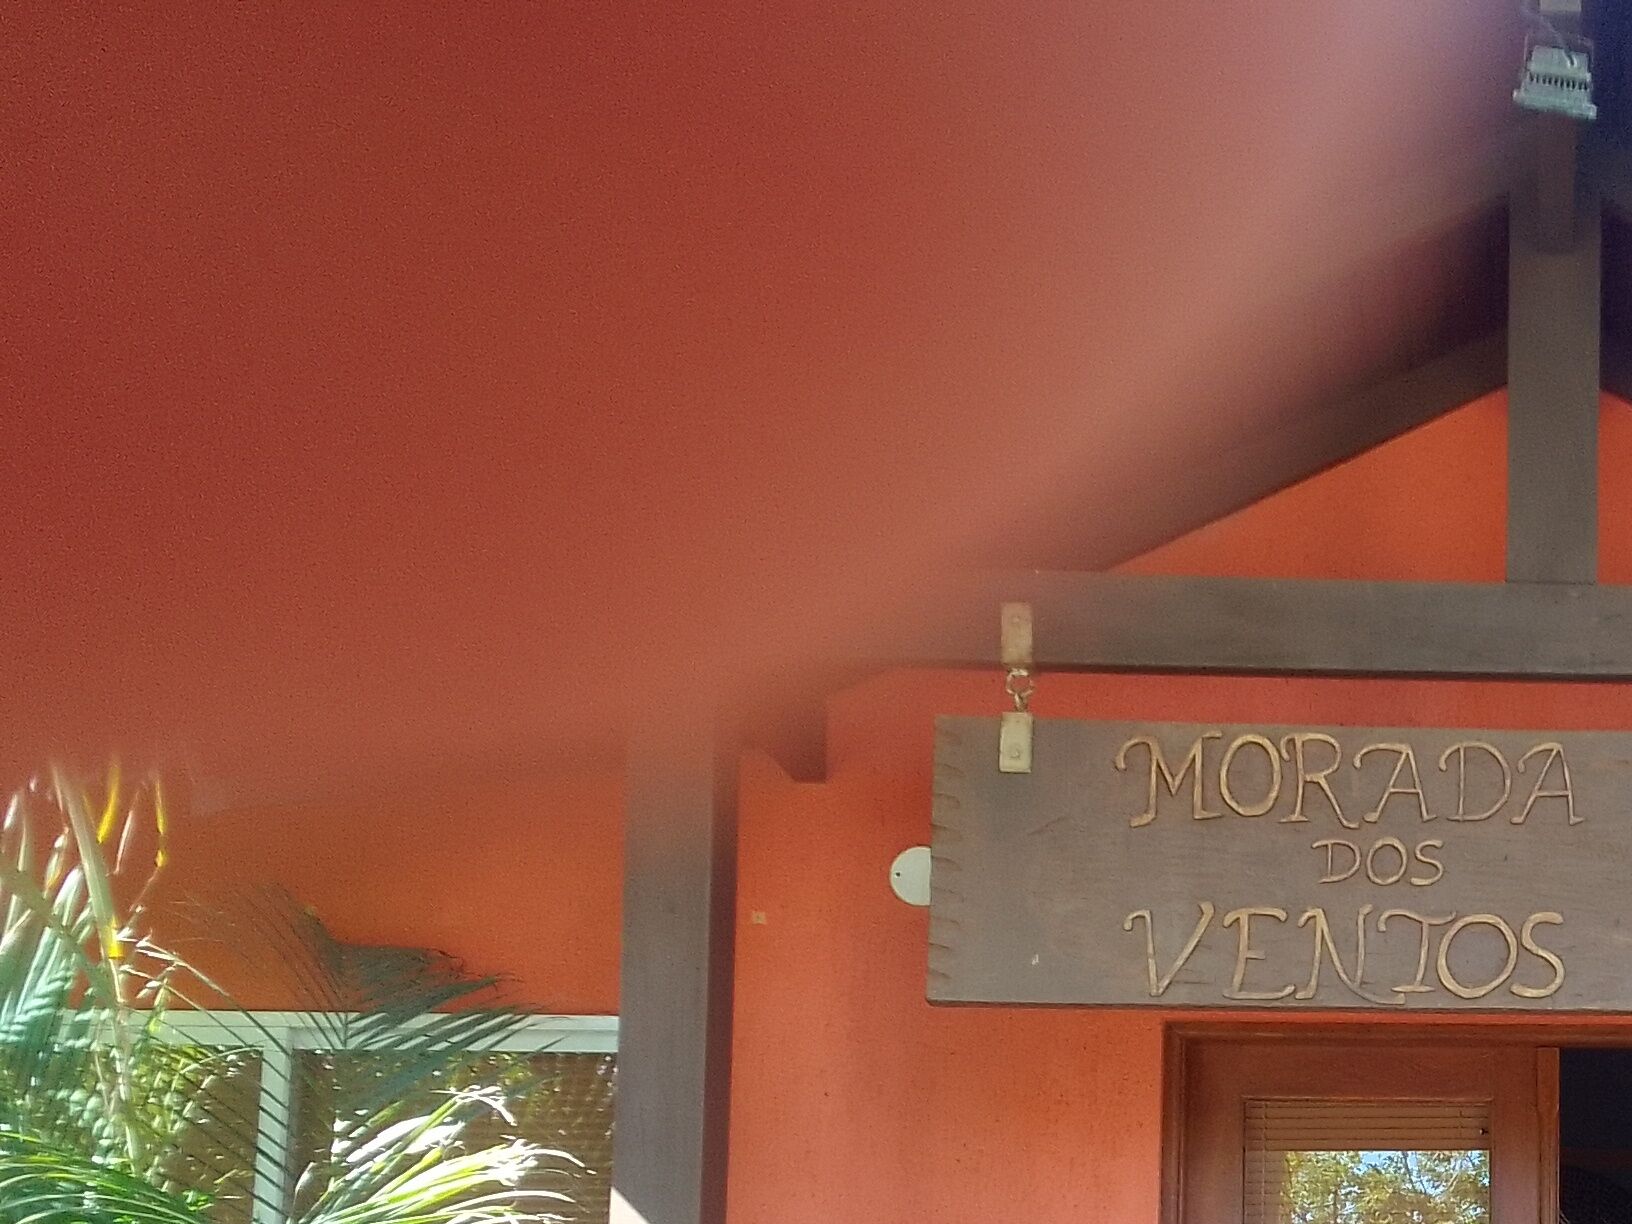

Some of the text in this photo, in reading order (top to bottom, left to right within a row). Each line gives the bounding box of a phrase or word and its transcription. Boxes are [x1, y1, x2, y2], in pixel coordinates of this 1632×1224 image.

[1114, 730, 1585, 829] MORADA
[1311, 836, 1445, 886] DOS
[1123, 901, 1566, 1005] VENTOS
